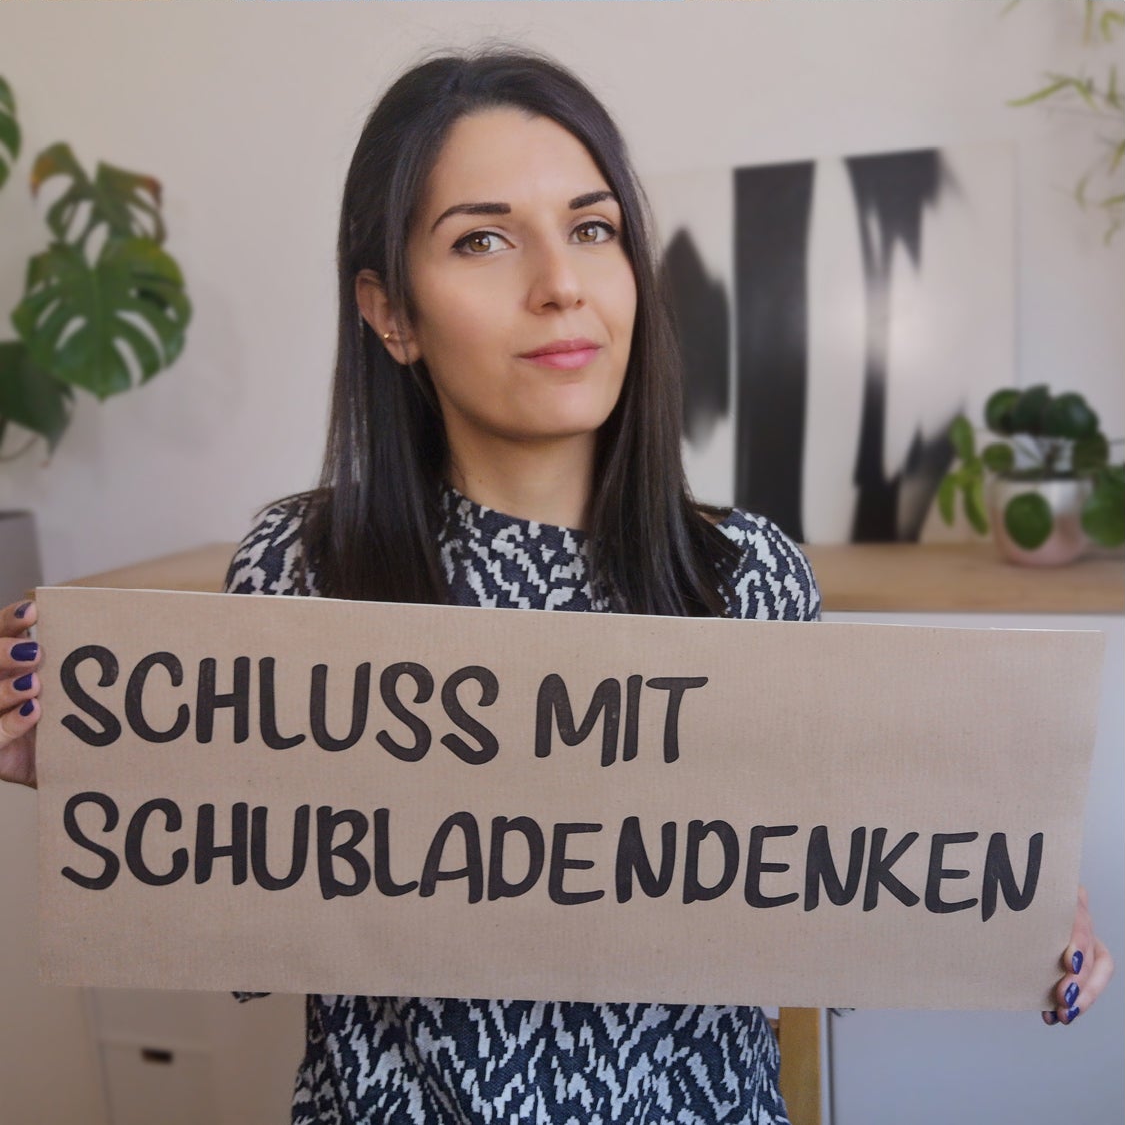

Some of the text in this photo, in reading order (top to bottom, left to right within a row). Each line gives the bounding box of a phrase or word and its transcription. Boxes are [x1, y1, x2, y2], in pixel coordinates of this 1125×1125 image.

[59, 644, 710, 768] SCHLUSS MIT
[60, 791, 1044, 923] SCHUBLADENDENKEN
